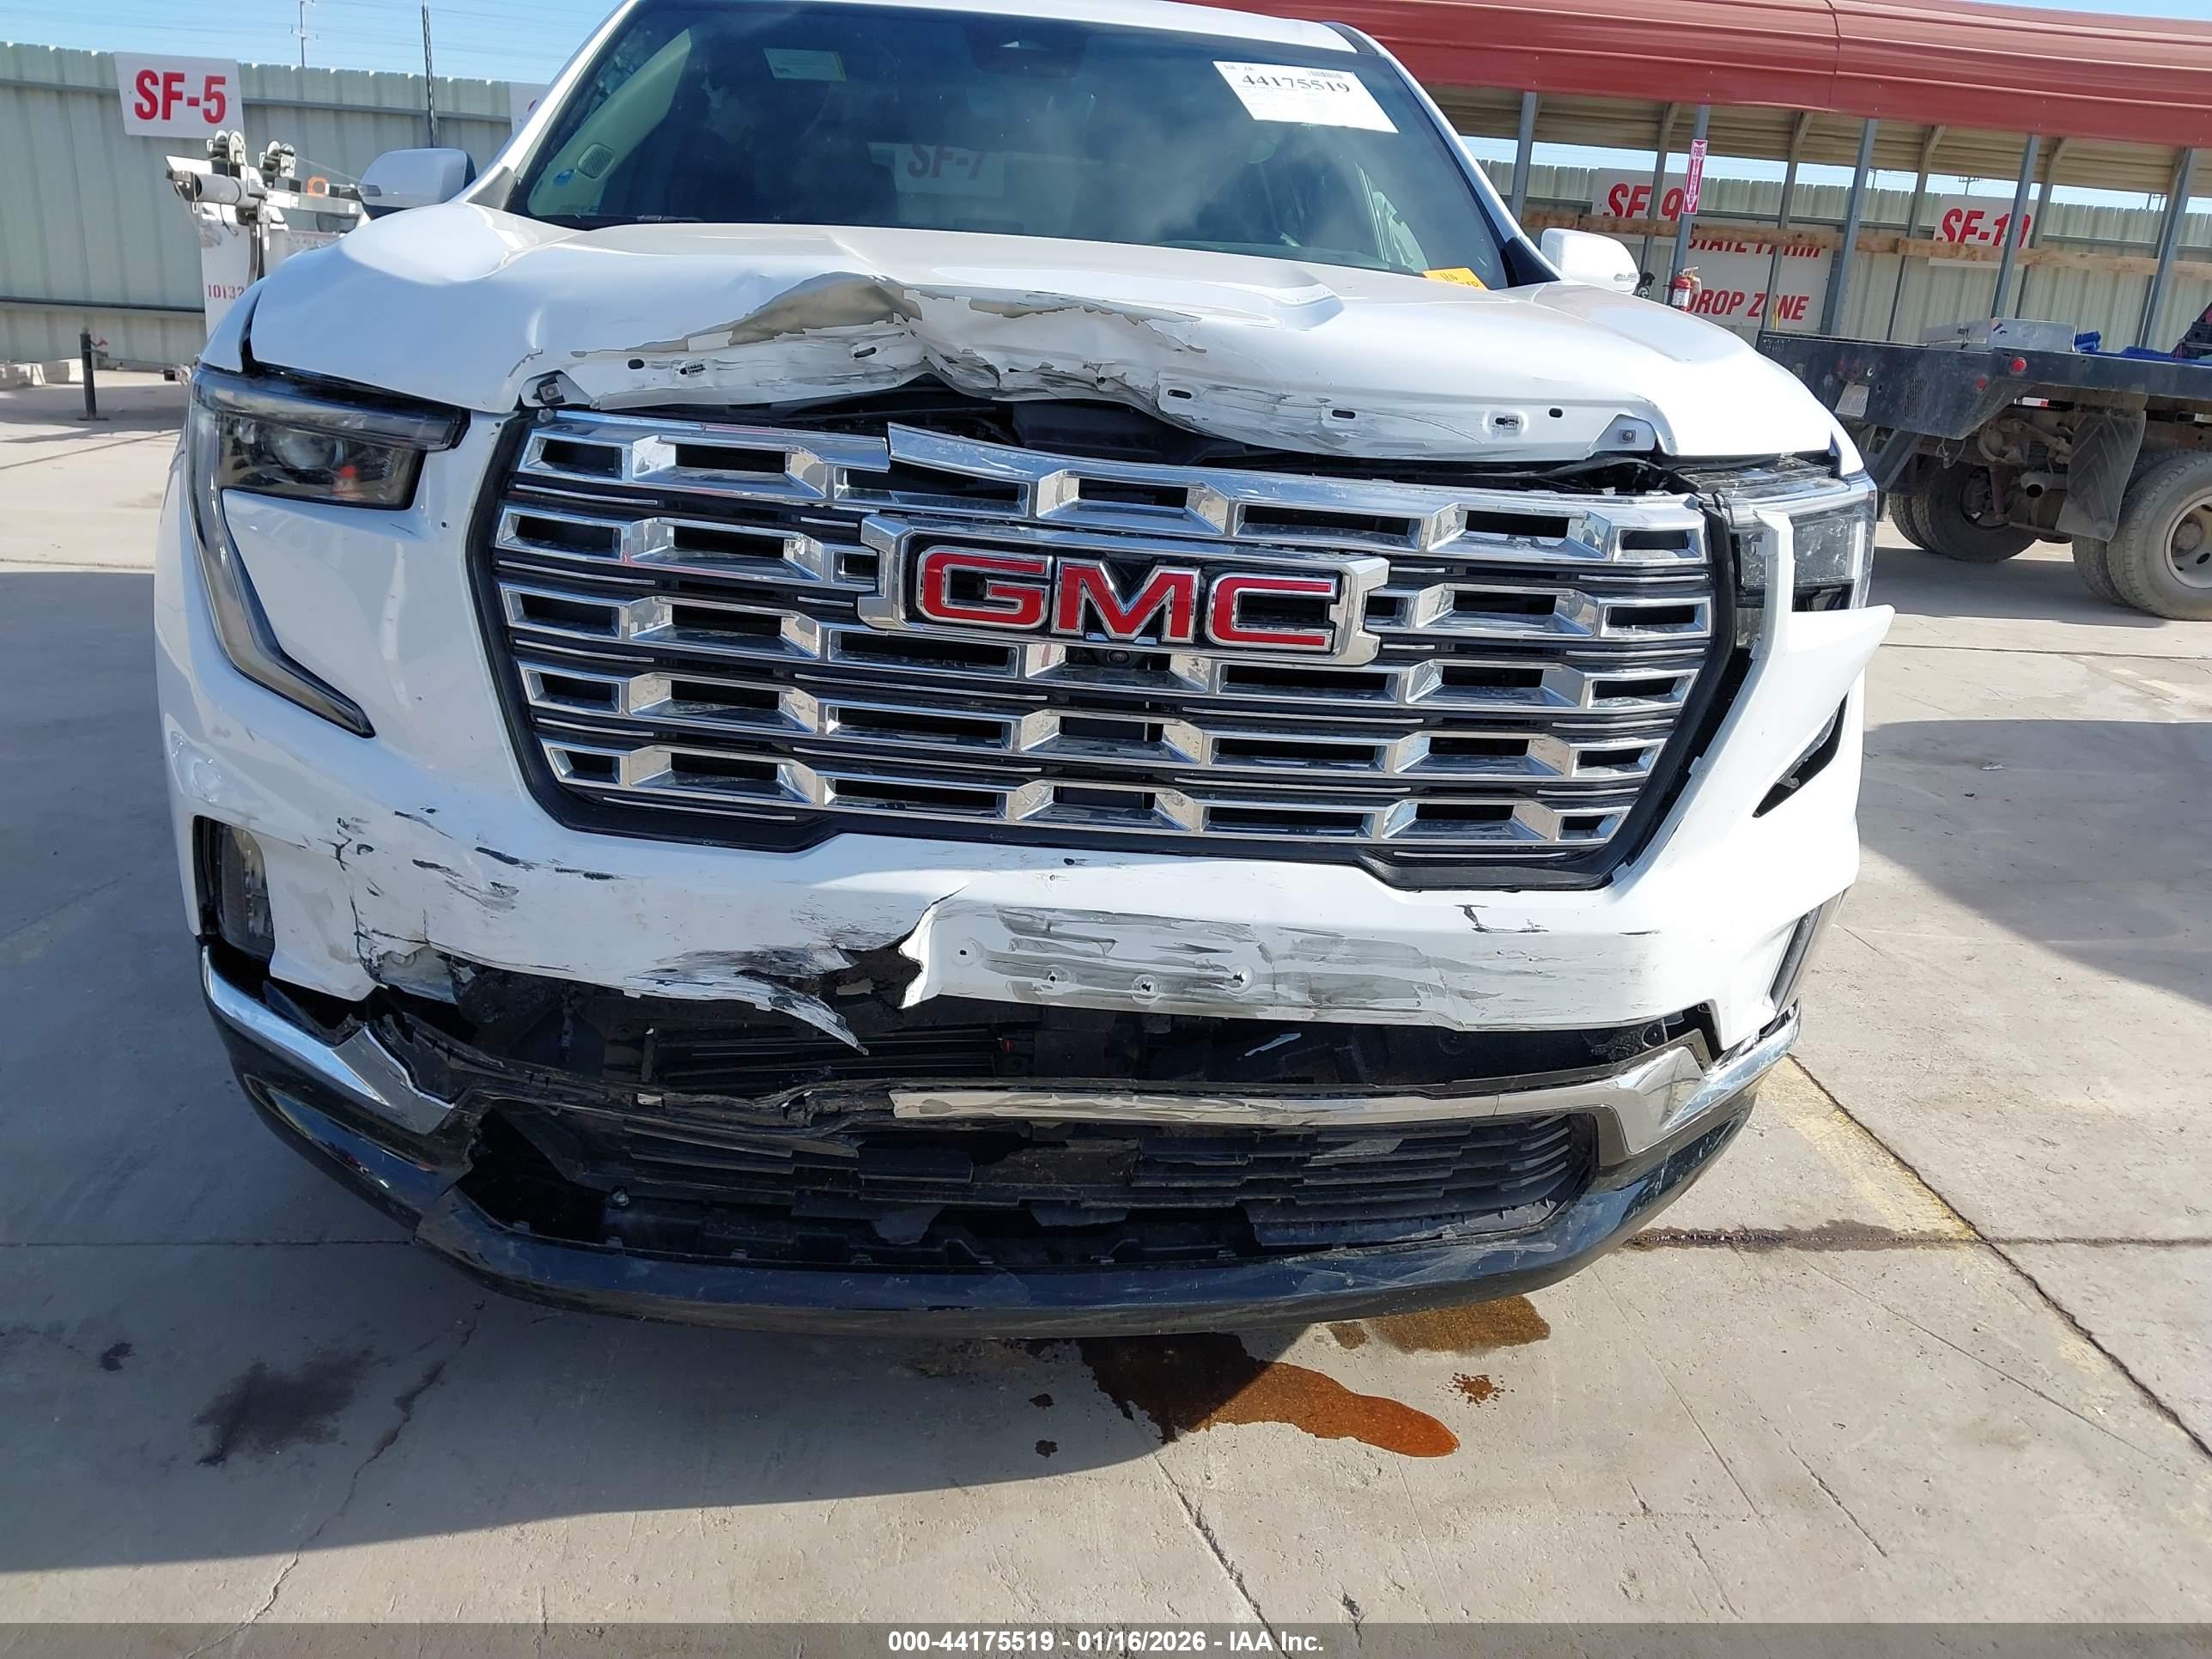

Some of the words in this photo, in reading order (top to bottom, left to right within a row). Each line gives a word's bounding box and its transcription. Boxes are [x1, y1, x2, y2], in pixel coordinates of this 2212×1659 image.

[134, 69, 227, 124] SF-5
[1243, 75, 1351, 93] 44175519
[916, 544, 1337, 653] GMC
